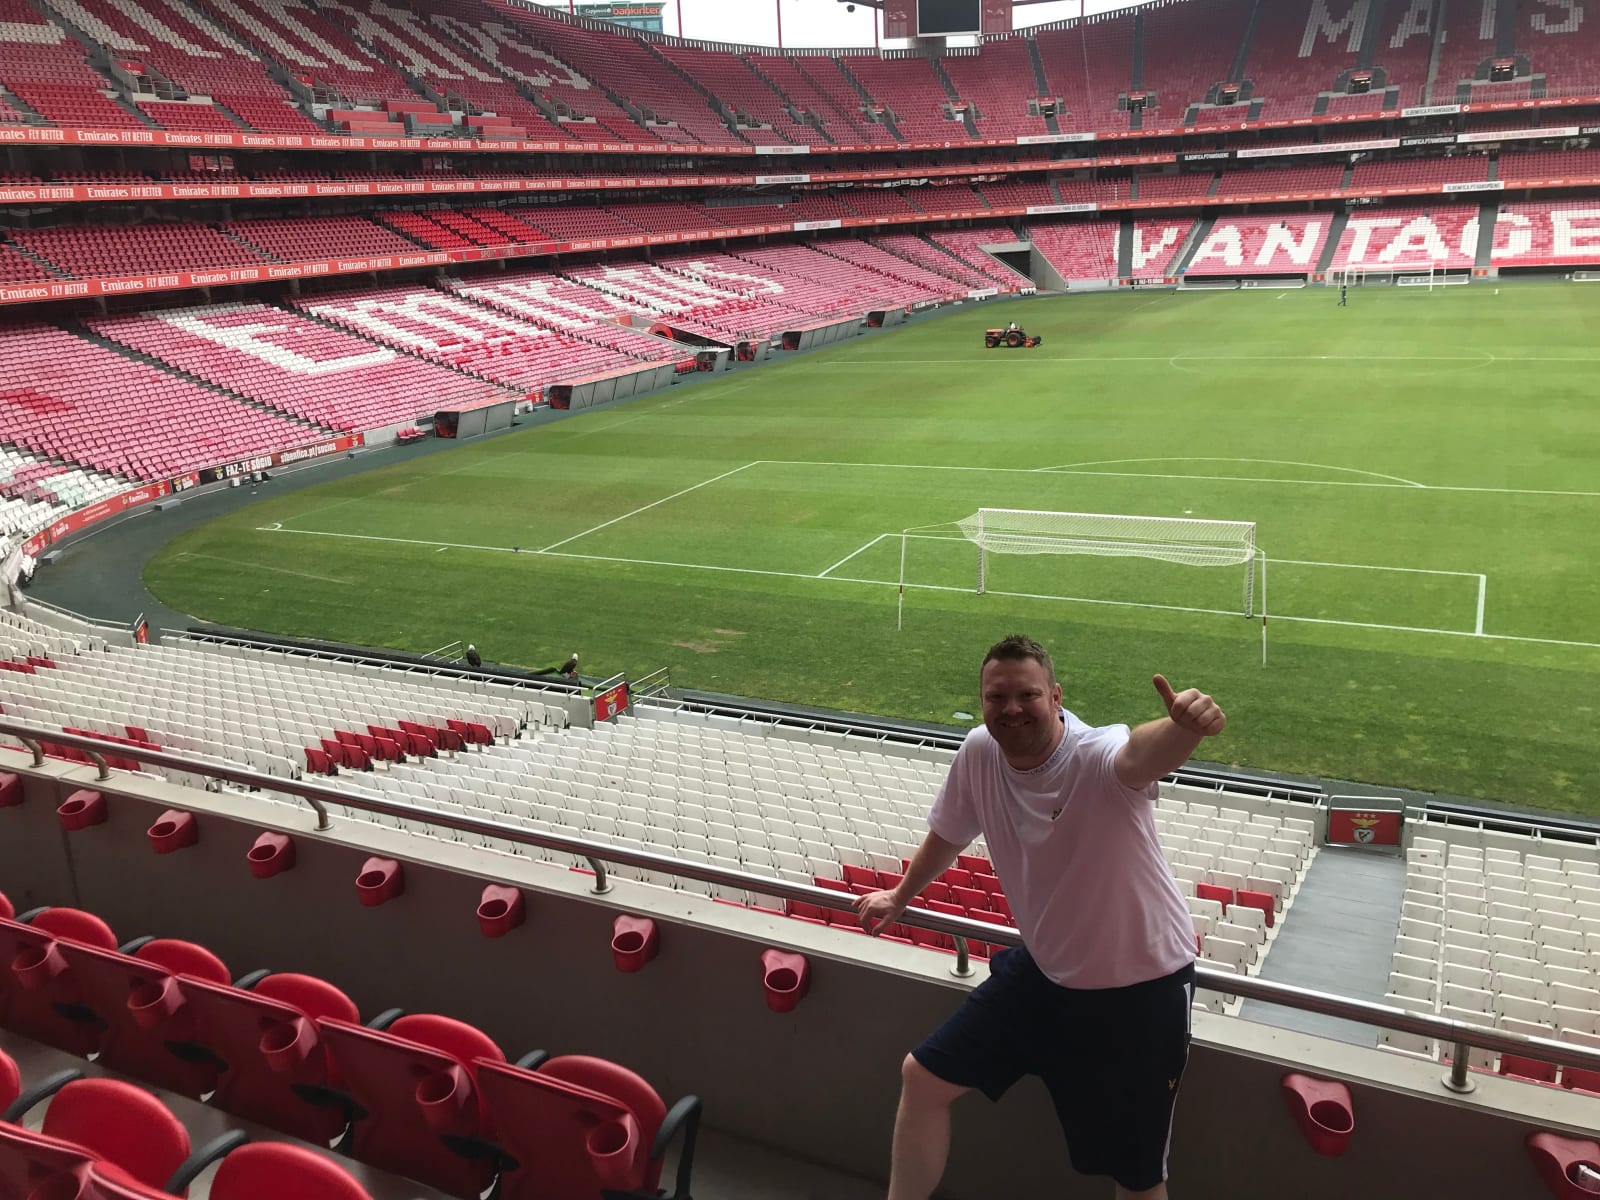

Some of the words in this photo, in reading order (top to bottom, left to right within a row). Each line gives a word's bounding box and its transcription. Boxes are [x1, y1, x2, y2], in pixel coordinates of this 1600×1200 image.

[613, 7, 659, 16] bankinter
[0, 130, 25, 139] rates
[28, 129, 39, 140] FLY
[41, 130, 64, 140] BETTER
[77, 131, 119, 141] Emirates
[121, 132, 131, 142] FLY
[132, 132, 153, 142] BETTER
[165, 133, 202, 144] Emirates
[204, 134, 213, 144] FLY
[214, 135, 232, 144] BETTER
[242, 135, 275, 145] Emirates
[311, 137, 340, 147] Emirates
[372, 139, 398, 148] Emirates
[428, 140, 451, 148] Emirates
[172, 186, 209, 196] Emirates
[211, 186, 219, 195] FLY
[221, 186, 239, 195] BETTER
[249, 186, 282, 195] Emirates
[316, 185, 345, 194] Emirates
[377, 184, 403, 193] Emirates
[432, 183, 455, 191] Emirates
[0, 189, 36, 200] mirates
[39, 189, 50, 199] FLY
[51, 188, 74, 199] BETTER
[87, 187, 128, 198] Emirates
[131, 187, 140, 197] FLY
[142, 187, 162, 197] BETTER
[338, 261, 367, 271] Emirates
[399, 257, 425, 266] Emirates
[190, 273, 228, 284] Emirates
[230, 271, 239, 280] FLY
[240, 269, 258, 280] BETTER
[268, 267, 301, 277] Emirates
[100, 280, 144, 292] Emirates
[147, 278, 156, 288] FLY
[158, 276, 178, 287] BETTER
[0, 288, 48, 300] Emirates
[51, 285, 62, 296] FLY
[64, 283, 88, 295] BETTER
[225, 460, 251, 477] FAZ-TE
